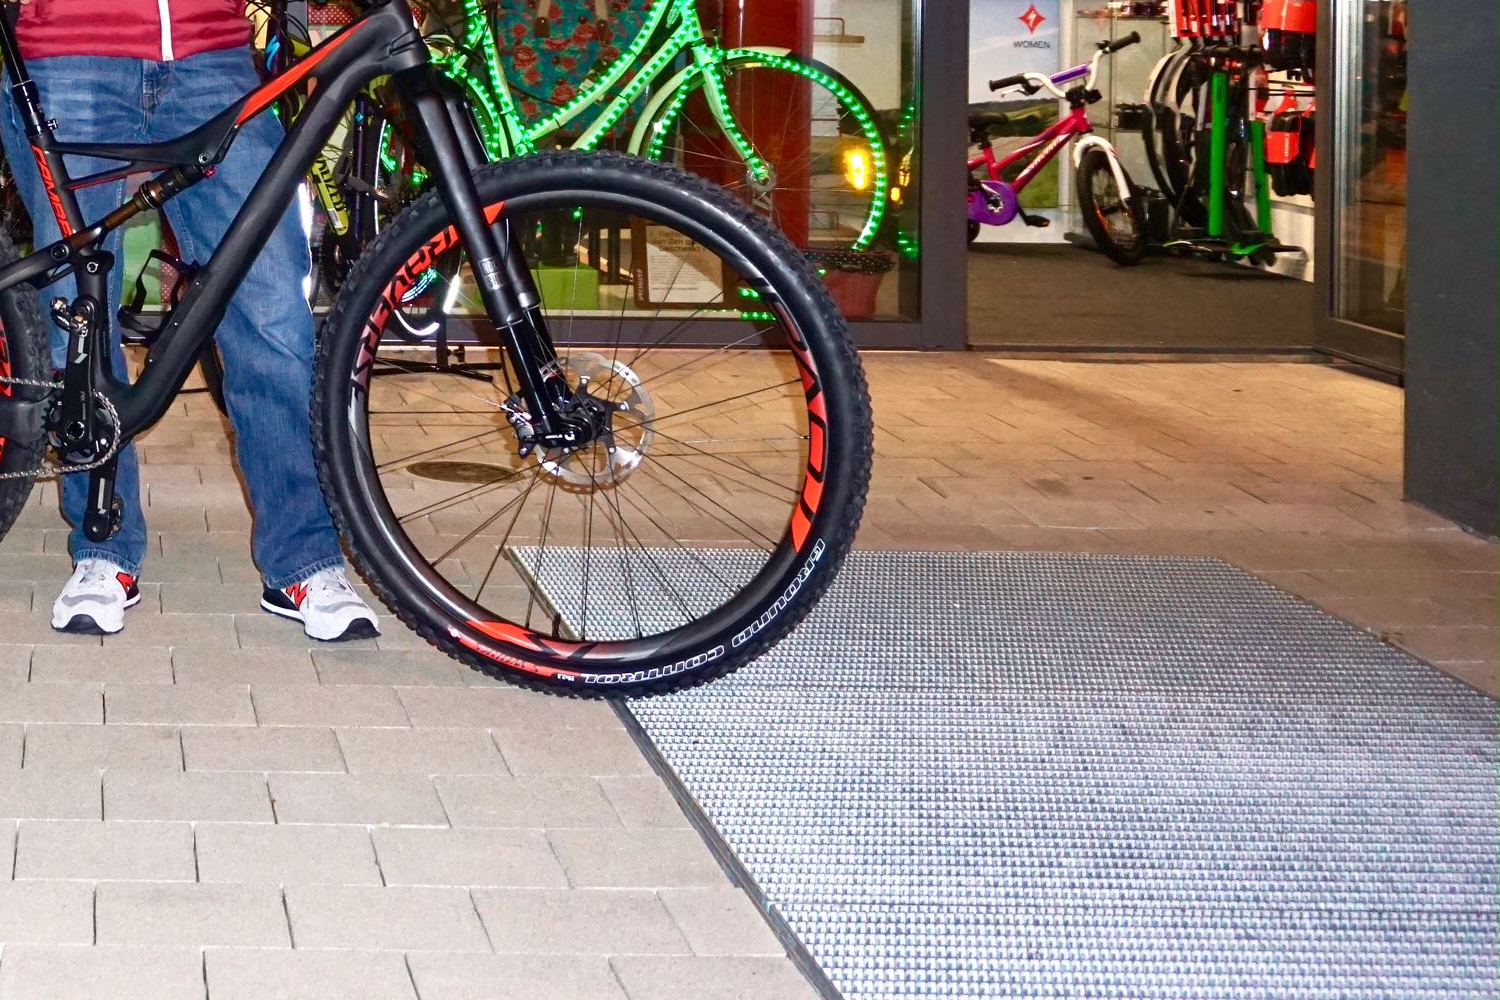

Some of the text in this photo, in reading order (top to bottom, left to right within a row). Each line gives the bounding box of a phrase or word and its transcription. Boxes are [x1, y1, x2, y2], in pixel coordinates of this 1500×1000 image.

[1013, 40, 1051, 49] WOMEN
[31, 145, 74, 239] CAMBE
[582, 538, 826, 684] GROUND CONTROL
